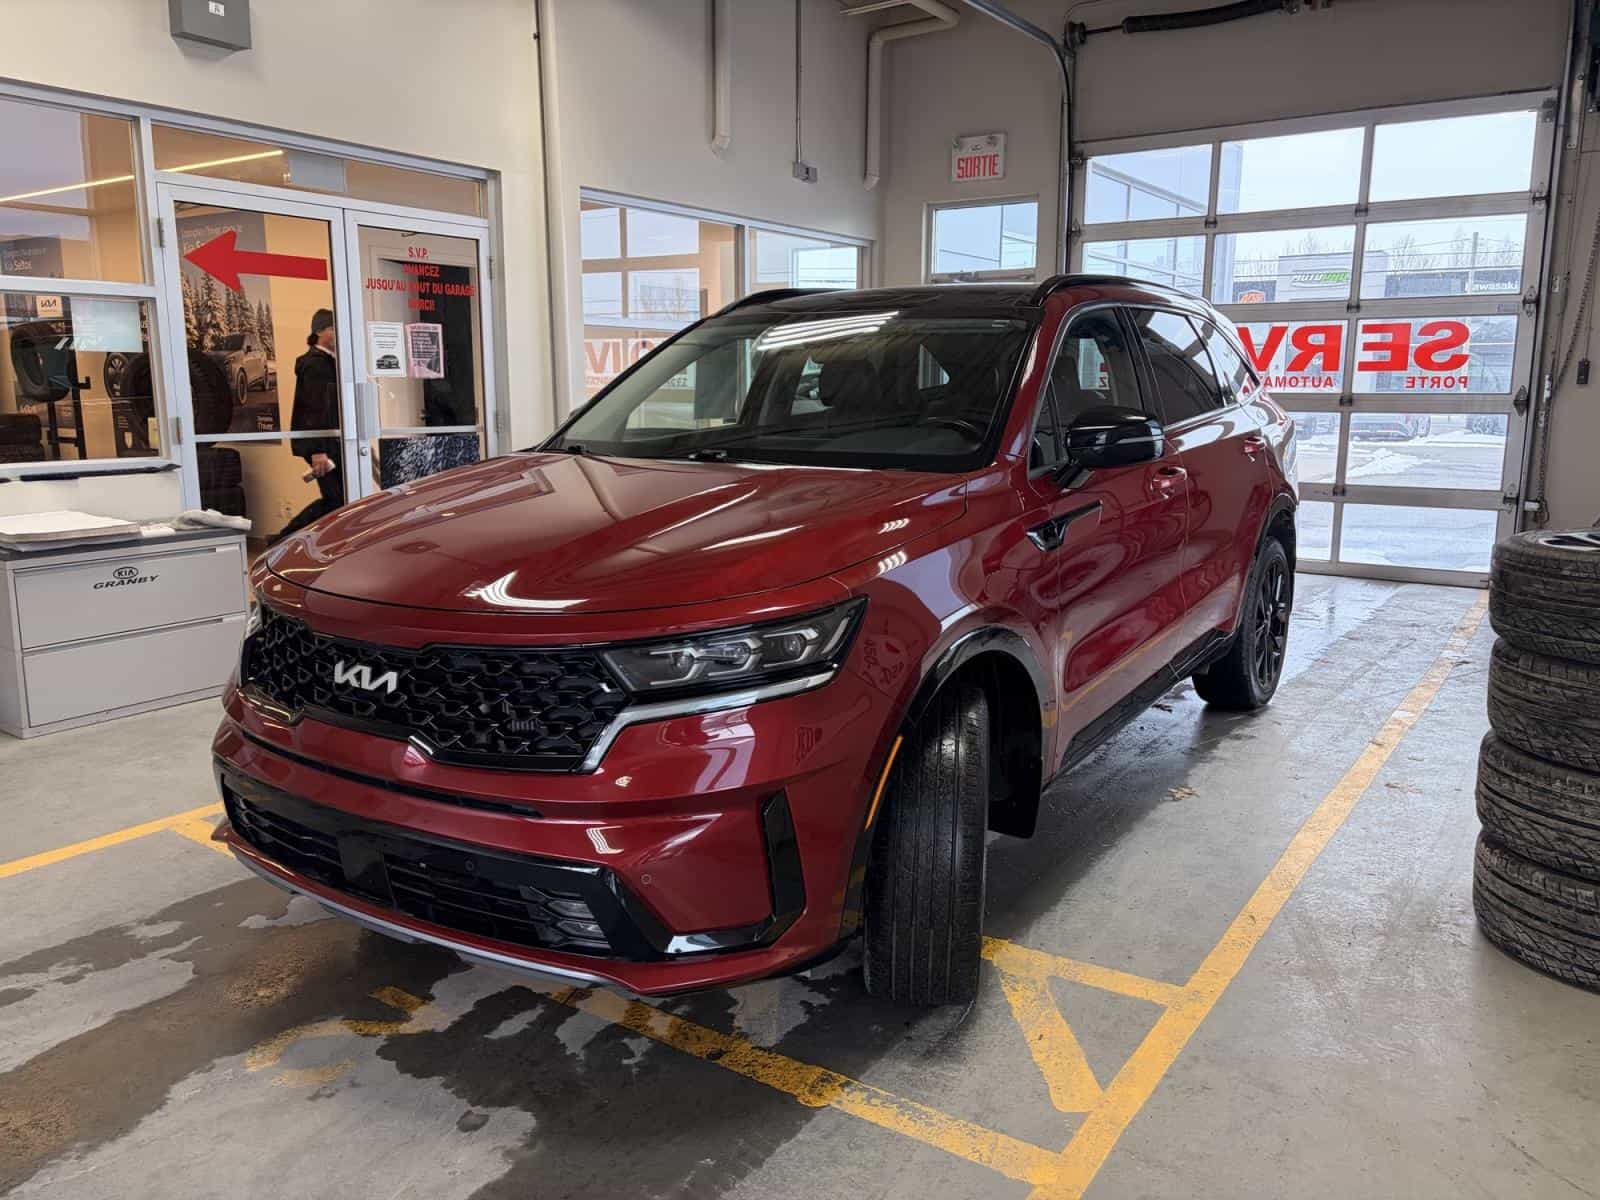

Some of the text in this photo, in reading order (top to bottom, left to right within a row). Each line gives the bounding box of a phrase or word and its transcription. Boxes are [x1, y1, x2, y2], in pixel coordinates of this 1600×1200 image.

[957, 153, 999, 178] SORTIE
[432, 283, 443, 295] DU
[445, 284, 476, 296] GARAGE
[93, 574, 159, 589] GRANBY
[334, 660, 398, 695] KIA
